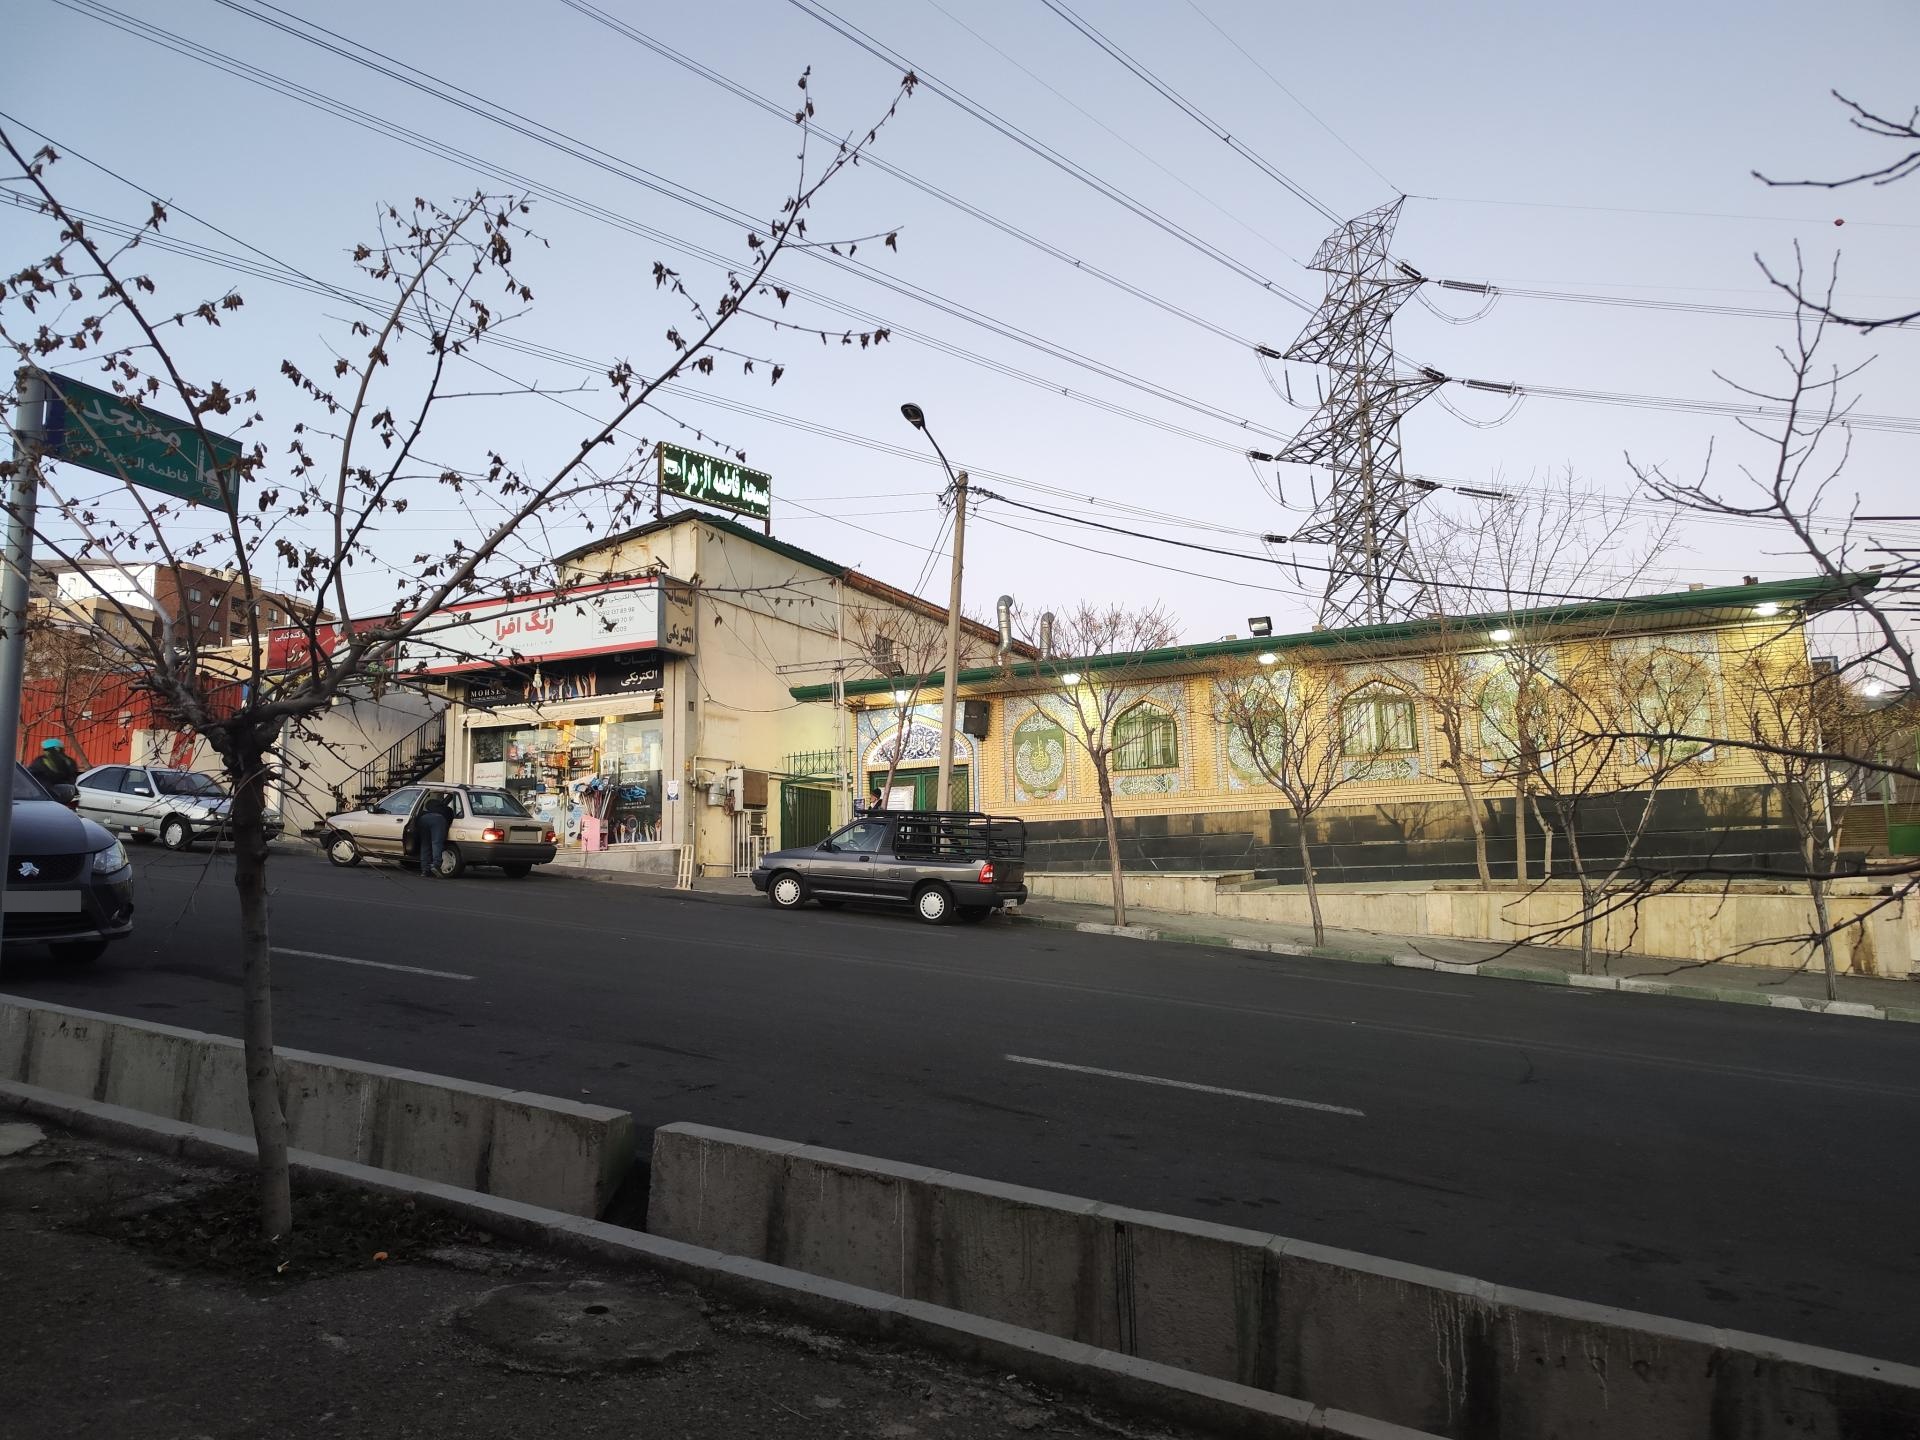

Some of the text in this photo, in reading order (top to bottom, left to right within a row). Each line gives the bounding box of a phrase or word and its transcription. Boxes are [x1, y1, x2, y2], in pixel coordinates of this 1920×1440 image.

[83, 398, 181, 448] مسجد
[147, 460, 190, 484] فاطمه
[713, 466, 740, 498] فاطمه
[742, 480, 769, 512] مسجد
[495, 610, 554, 641] رنگ افرا
[666, 623, 694, 647] الکتریکی
[620, 669, 658, 687] الکتریکی
